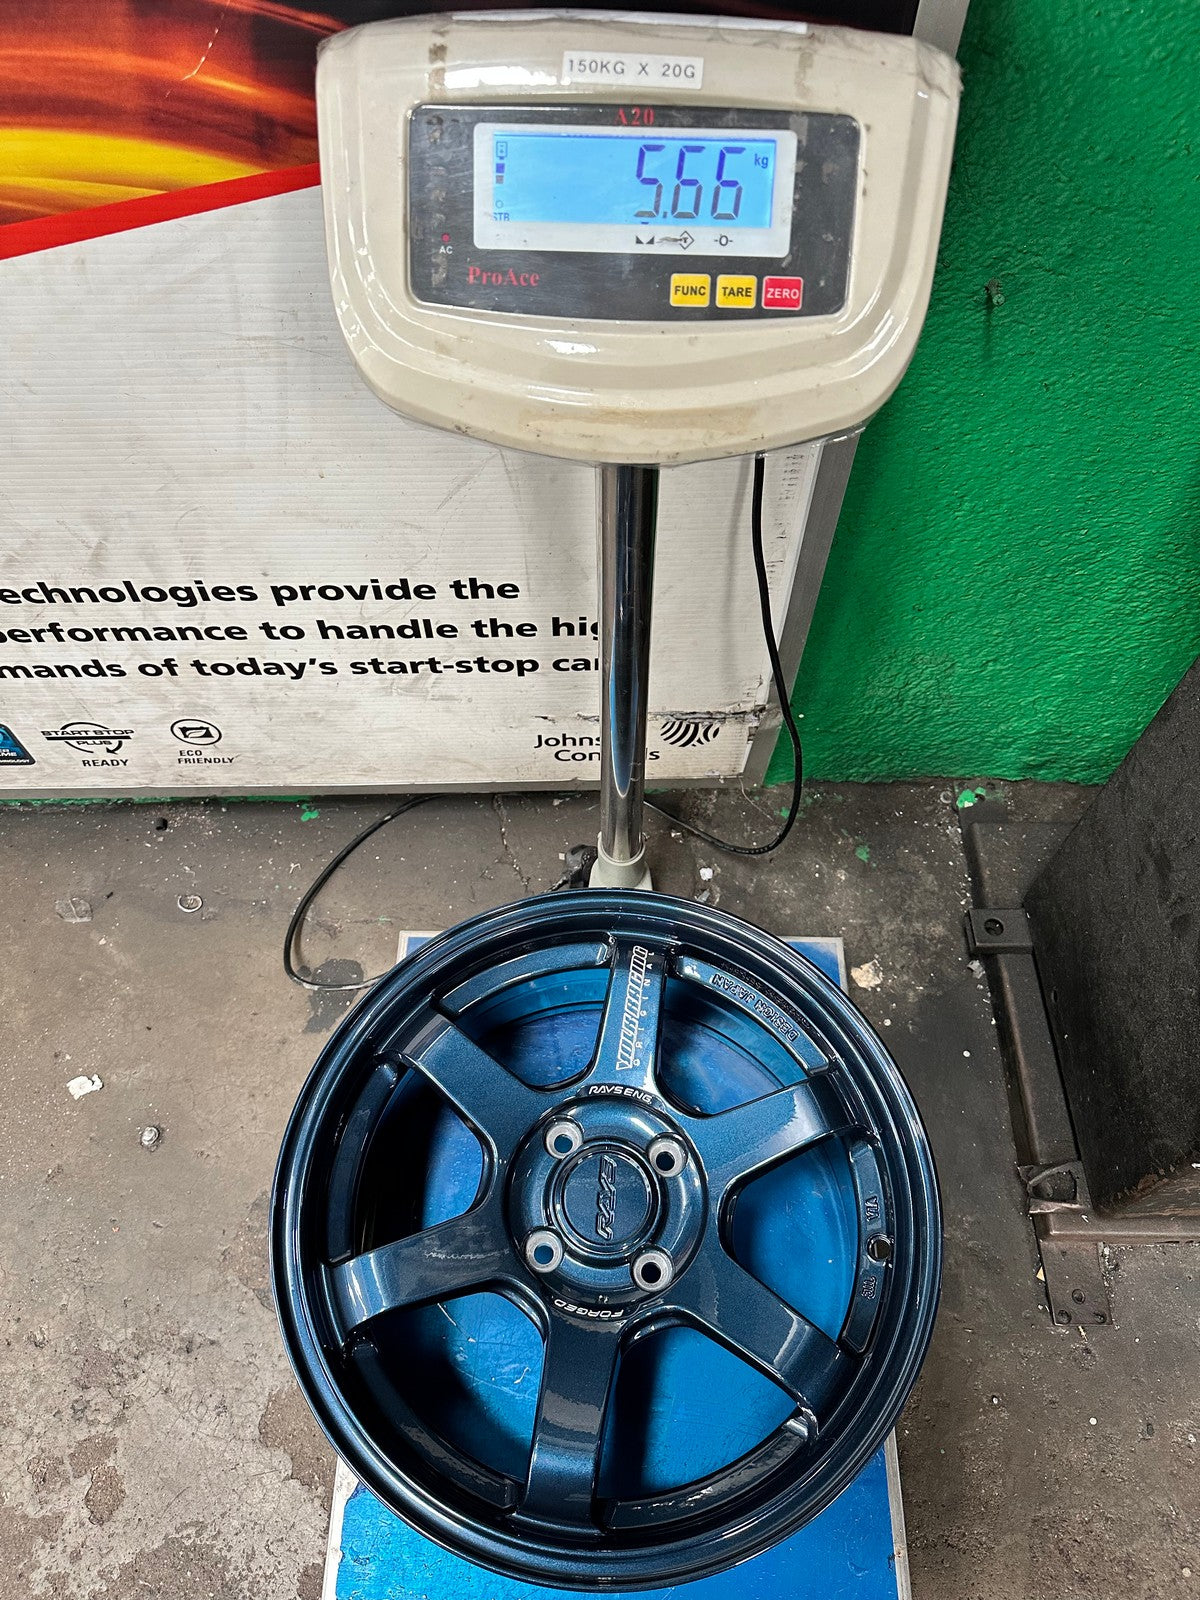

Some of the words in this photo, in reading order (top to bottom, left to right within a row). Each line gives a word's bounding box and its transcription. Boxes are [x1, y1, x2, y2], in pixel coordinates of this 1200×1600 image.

[568, 59, 625, 75] 150KG
[638, 62, 649, 76] X
[662, 63, 695, 79] 20G
[615, 106, 655, 126] A20
[634, 144, 746, 220] 5.66
[754, 154, 769, 168] kg
[439, 245, 453, 254] AC
[467, 265, 540, 287] ProAce
[674, 285, 706, 296] FUNC
[722, 286, 752, 298] TARE
[766, 287, 800, 299] ZERO
[0, 580, 258, 607] echnologies
[270, 578, 436, 607] provide
[449, 576, 520, 600] the
[258, 621, 306, 640] to
[316, 619, 458, 640] handle
[471, 617, 538, 638] the
[0, 659, 127, 678] mands
[138, 657, 179, 677] of
[190, 657, 339, 680] today's
[351, 656, 540, 677] start-stop
[534, 733, 600, 748] John
[82, 759, 129, 767] READY
[179, 749, 203, 757] ECO
[709, 972, 756, 1004] JAPAN
[753, 999, 800, 1043] DESIGN
[553, 1298, 625, 1318] FORGED
